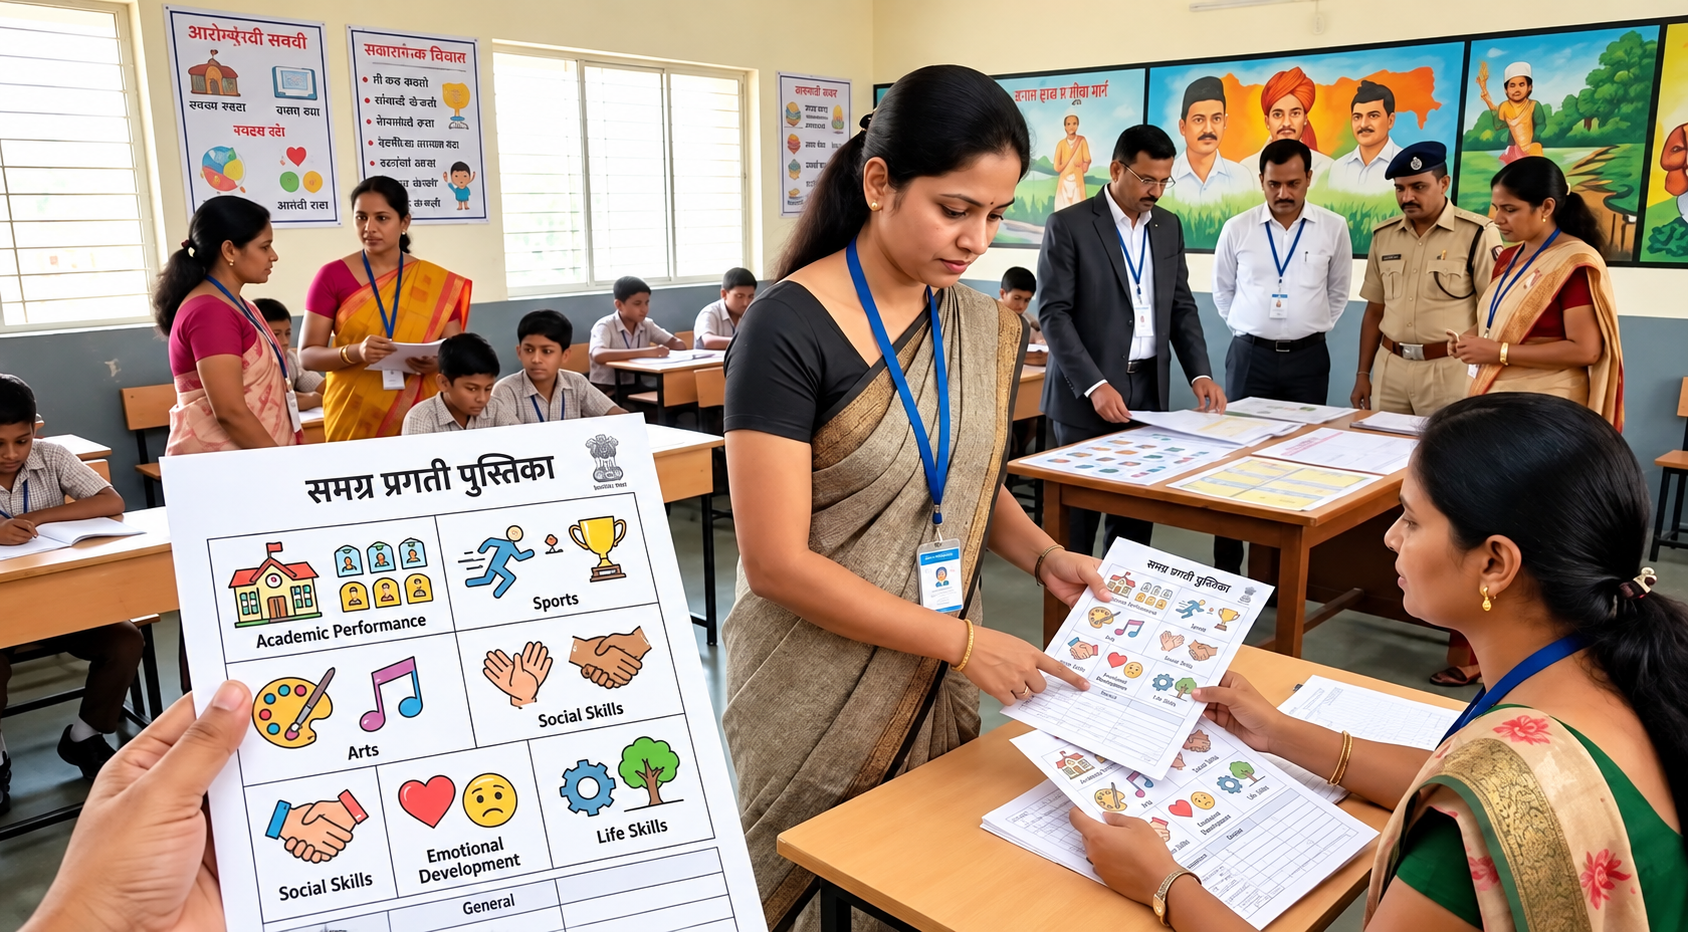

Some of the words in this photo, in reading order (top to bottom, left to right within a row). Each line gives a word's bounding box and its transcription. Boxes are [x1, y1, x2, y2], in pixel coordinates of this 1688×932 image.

[305, 474, 374, 503] समग्र
[380, 458, 452, 497] प्रगती
[457, 453, 555, 497] पुस्तिका
[533, 592, 579, 612] Sports
[256, 626, 329, 648] Academic
[333, 616, 427, 638] Performance
[538, 706, 582, 728] Social
[585, 701, 624, 721] Skills
[347, 743, 379, 761] Arts
[597, 826, 625, 844] Life
[628, 819, 668, 838] Skills
[427, 837, 504, 864] Emotional
[418, 854, 521, 884] Development
[279, 879, 328, 901] Social
[330, 872, 373, 894] Skills
[462, 893, 515, 915] General
